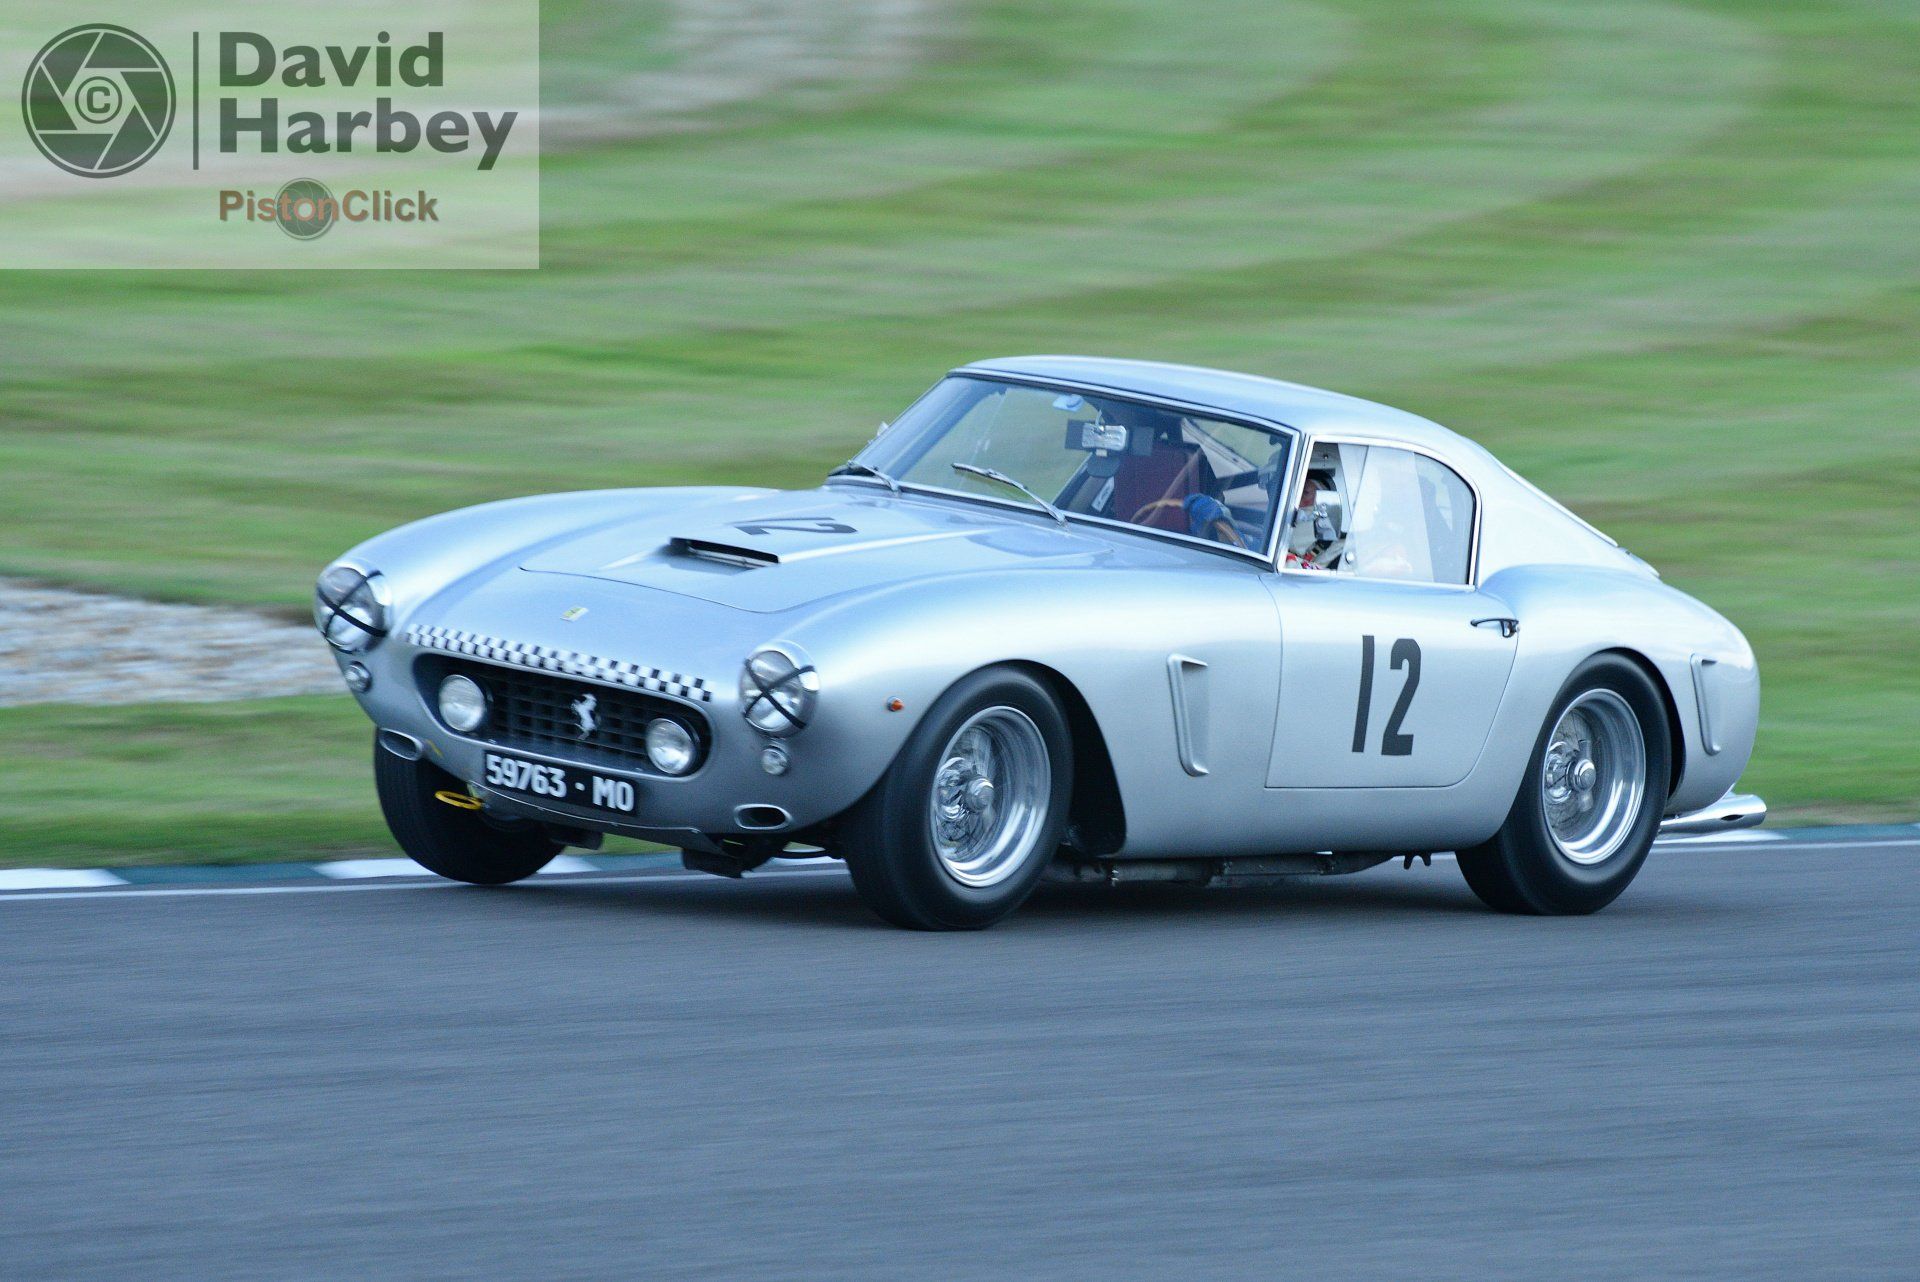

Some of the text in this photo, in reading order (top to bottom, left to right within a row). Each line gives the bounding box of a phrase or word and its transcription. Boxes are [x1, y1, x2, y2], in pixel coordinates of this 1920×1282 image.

[1352, 635, 1422, 756] 12
[485, 753, 635, 812] 59763 MO
